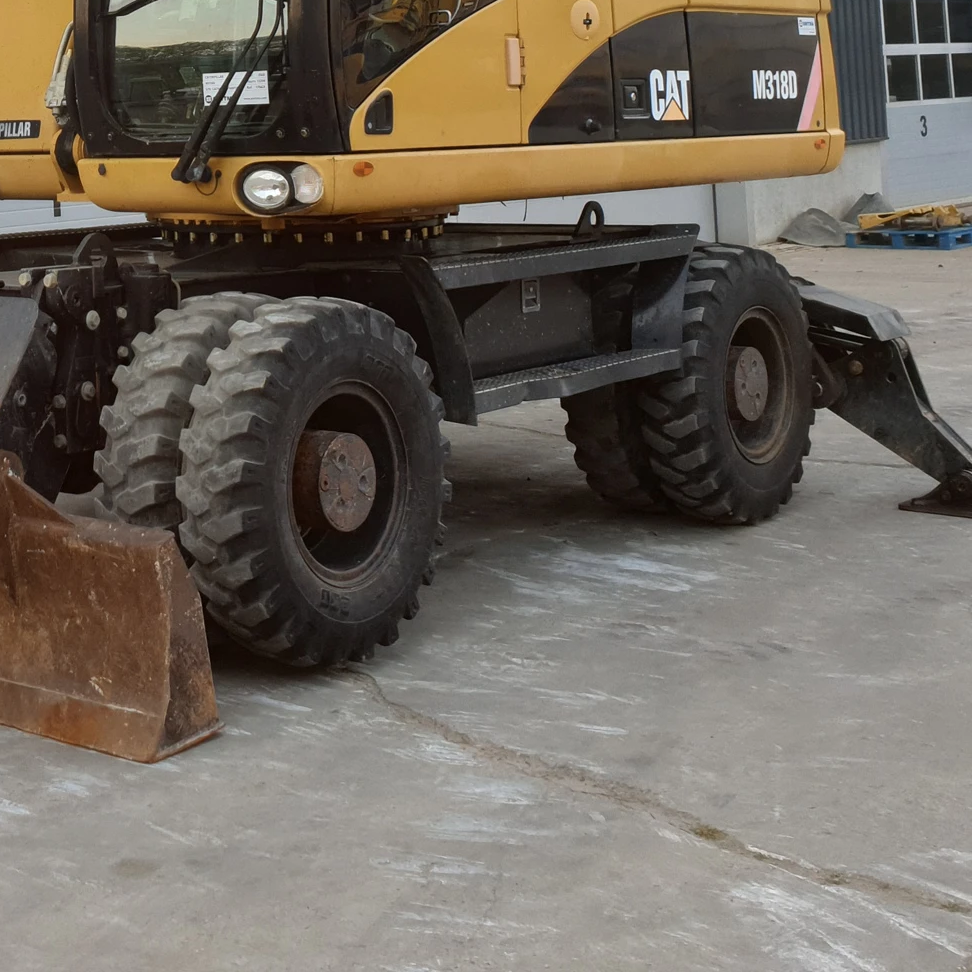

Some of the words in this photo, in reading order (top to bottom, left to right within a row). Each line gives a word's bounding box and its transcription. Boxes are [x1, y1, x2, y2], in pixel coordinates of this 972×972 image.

[649, 69, 689, 121] CAT
[752, 69, 797, 100] M318D
[919, 115, 928, 137] 3
